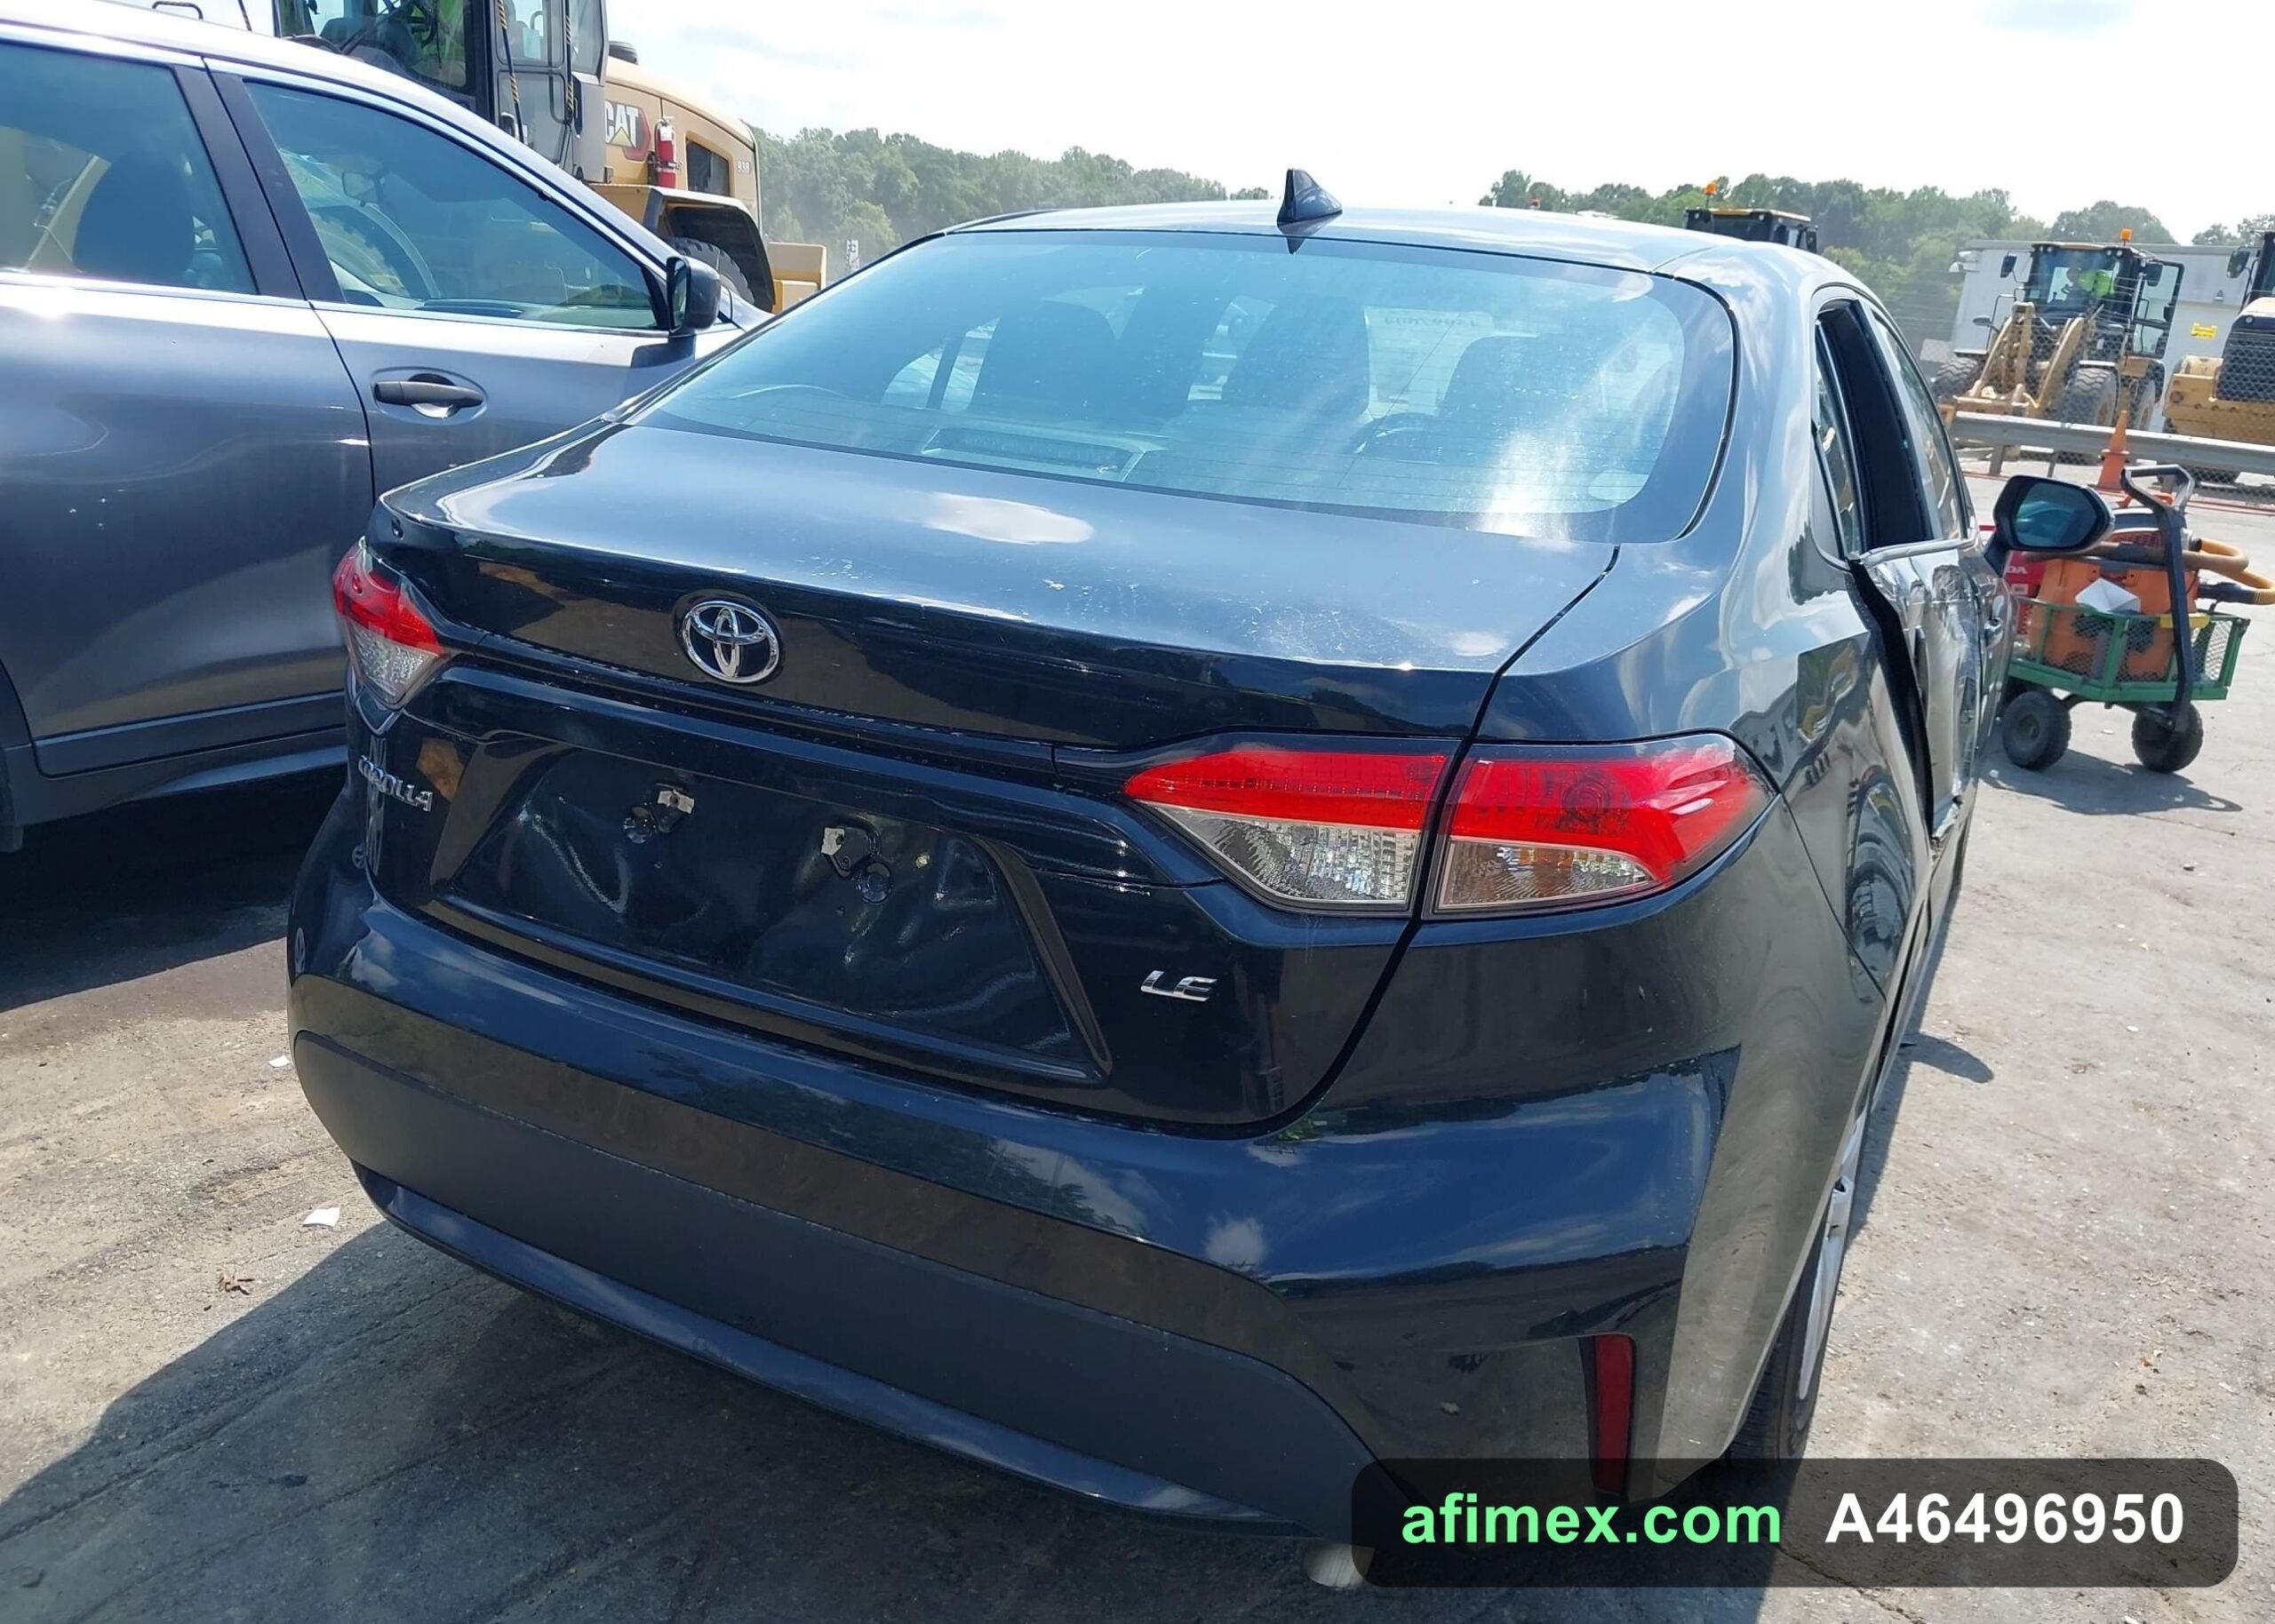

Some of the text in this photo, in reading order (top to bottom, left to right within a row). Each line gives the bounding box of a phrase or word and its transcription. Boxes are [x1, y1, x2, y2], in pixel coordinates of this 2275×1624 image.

[604, 100, 639, 147] CAT
[358, 755, 434, 812] COROLLA
[1140, 969, 1217, 1002] LE
